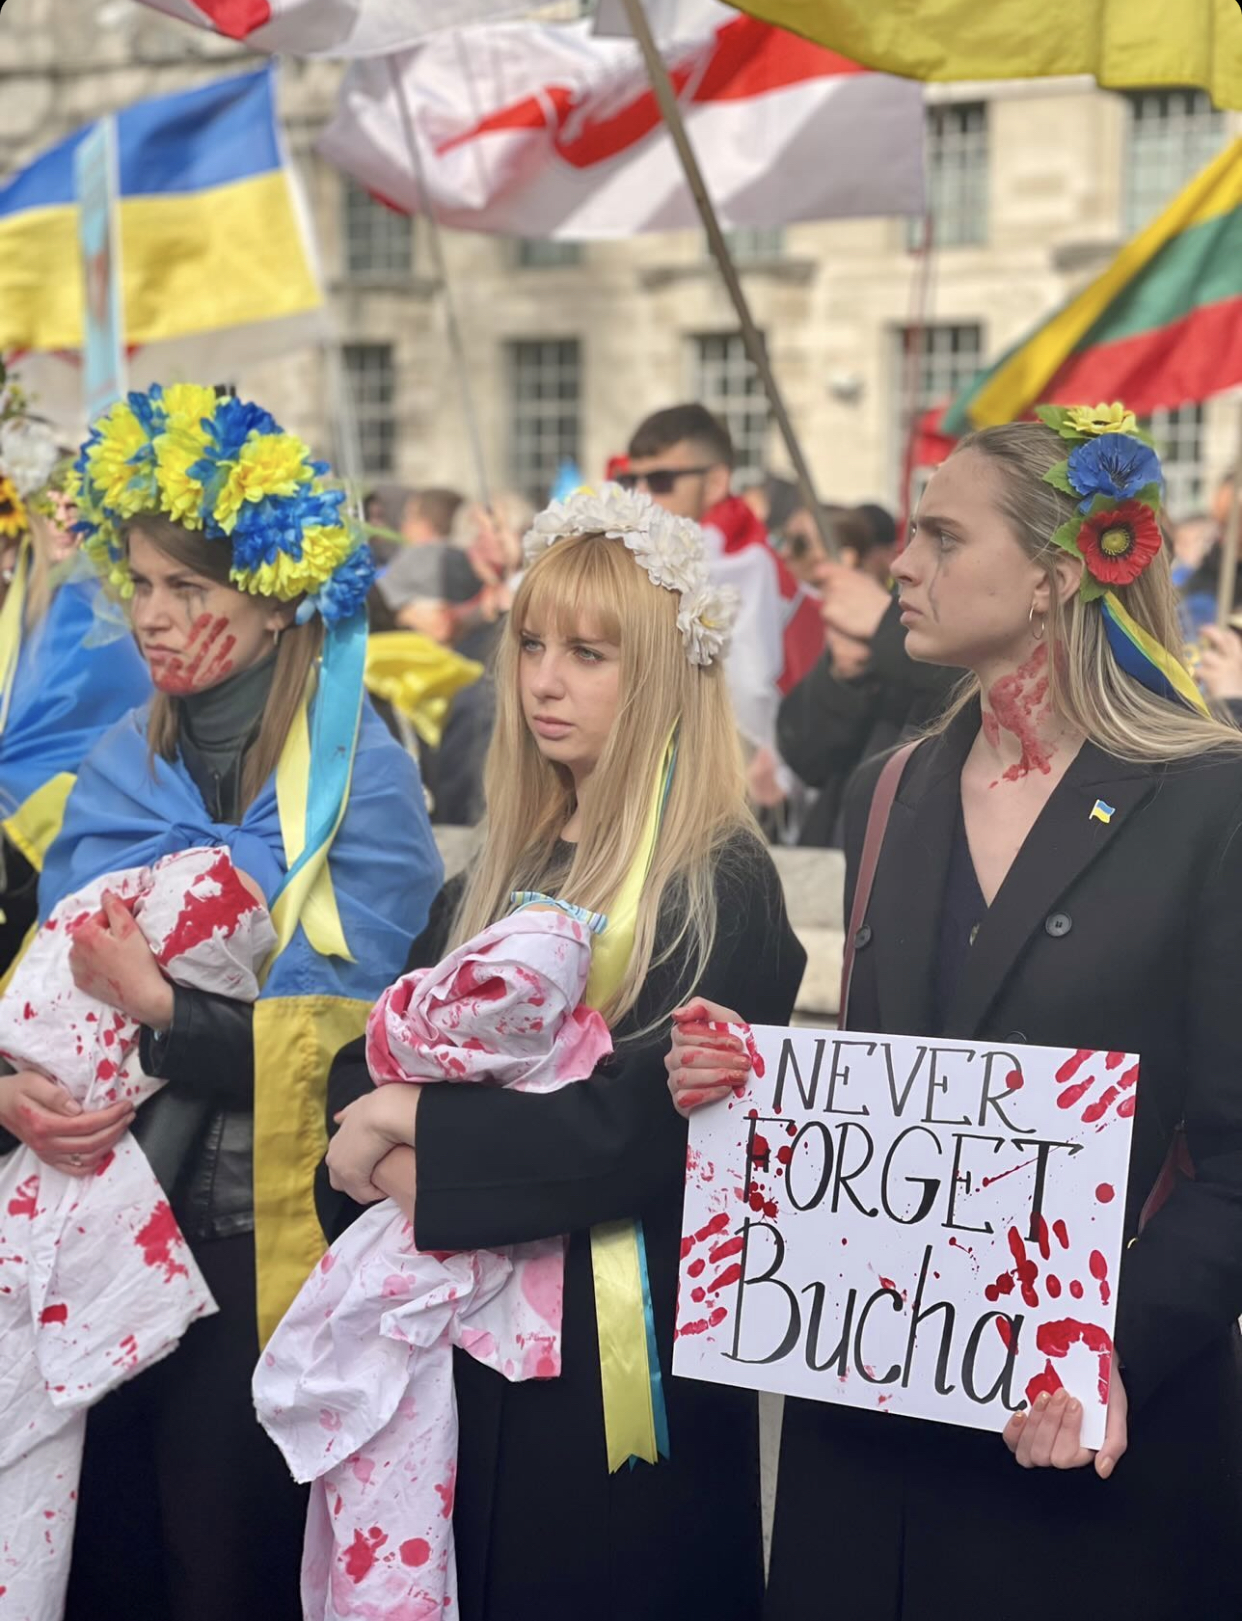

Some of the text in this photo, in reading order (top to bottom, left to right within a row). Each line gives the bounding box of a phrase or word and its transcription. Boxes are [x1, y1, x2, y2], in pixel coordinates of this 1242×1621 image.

[772, 1038, 1037, 1133] NEVER
[743, 1115, 1084, 1243] FORGET
[720, 1217, 1028, 1412] Bucha
